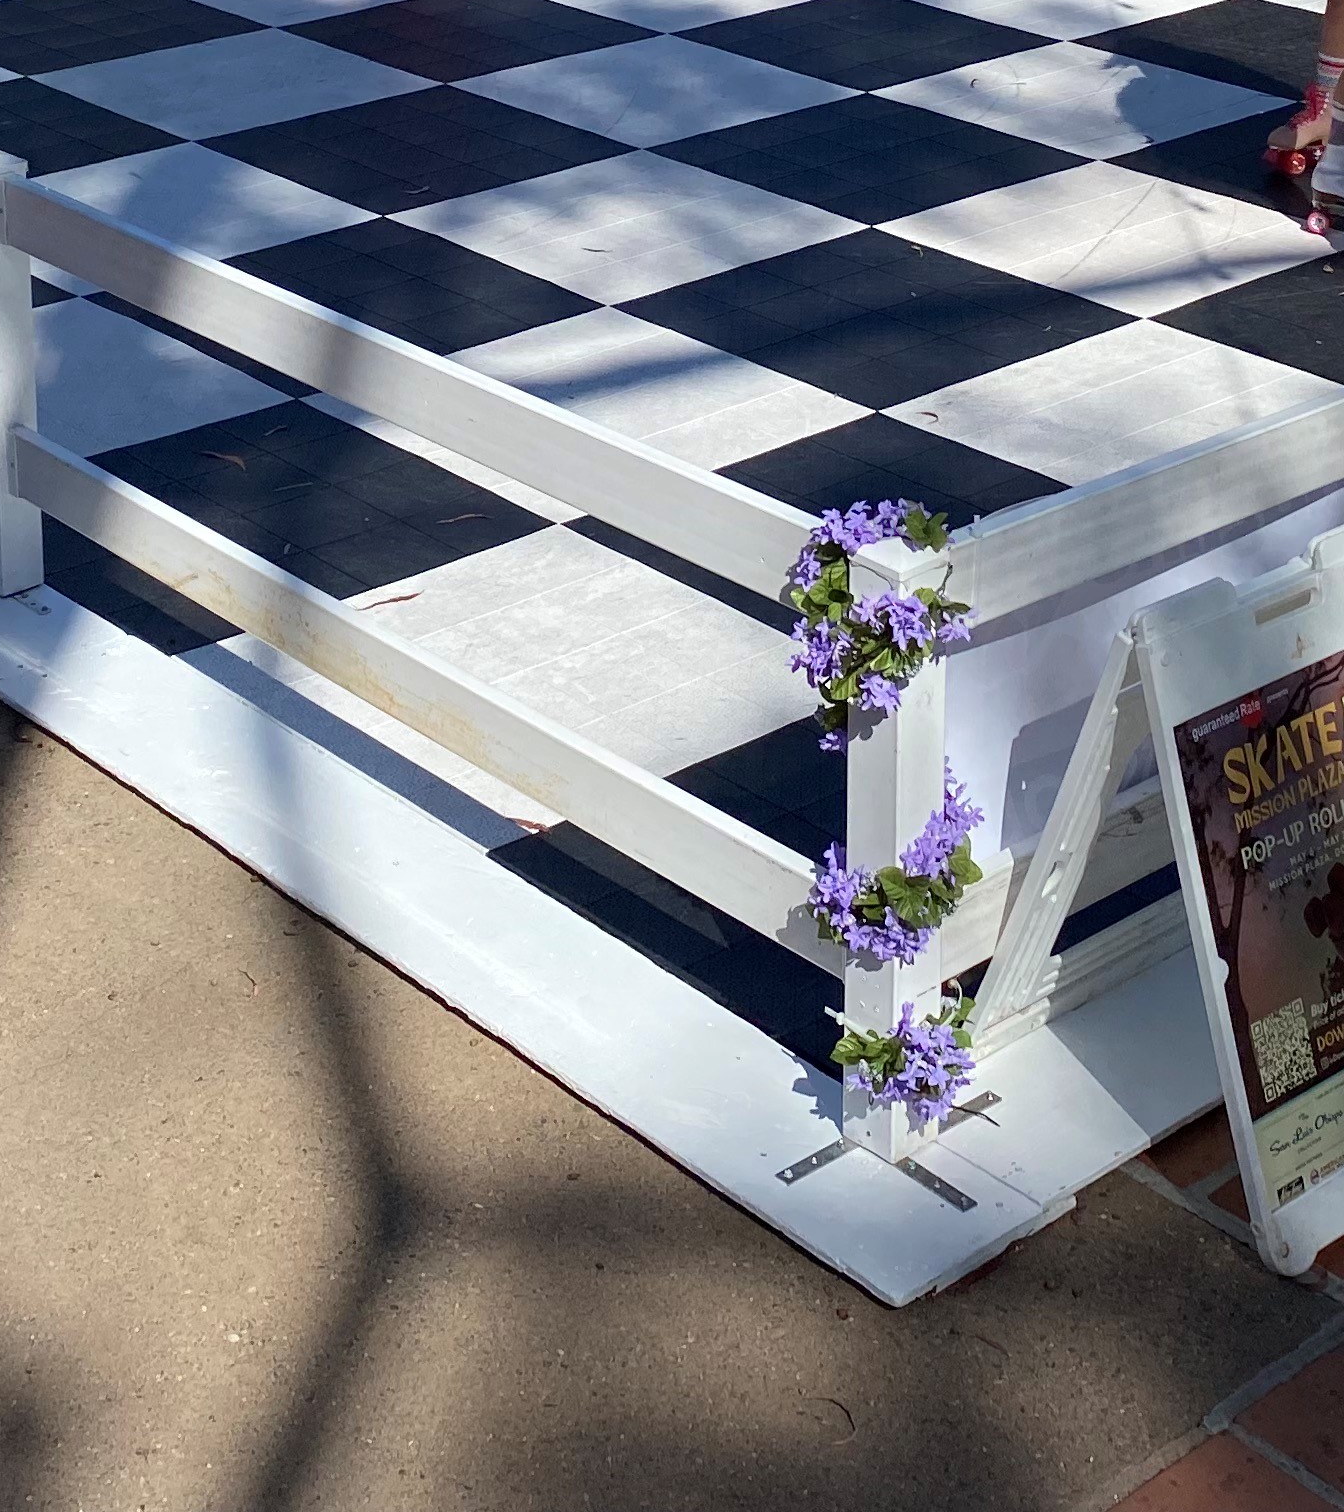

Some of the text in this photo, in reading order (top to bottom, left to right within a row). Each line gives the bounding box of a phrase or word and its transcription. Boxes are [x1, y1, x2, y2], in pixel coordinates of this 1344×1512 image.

[1223, 702, 1343, 804] SKATE
[1234, 789, 1297, 834] MISSION
[1240, 820, 1304, 870] POP-UP
[1289, 851, 1306, 867] MAY
[1323, 836, 1341, 849] MAY
[1269, 867, 1304, 891] MISSION
[1310, 999, 1329, 1018] Buy
[1269, 1139, 1291, 1157] San
